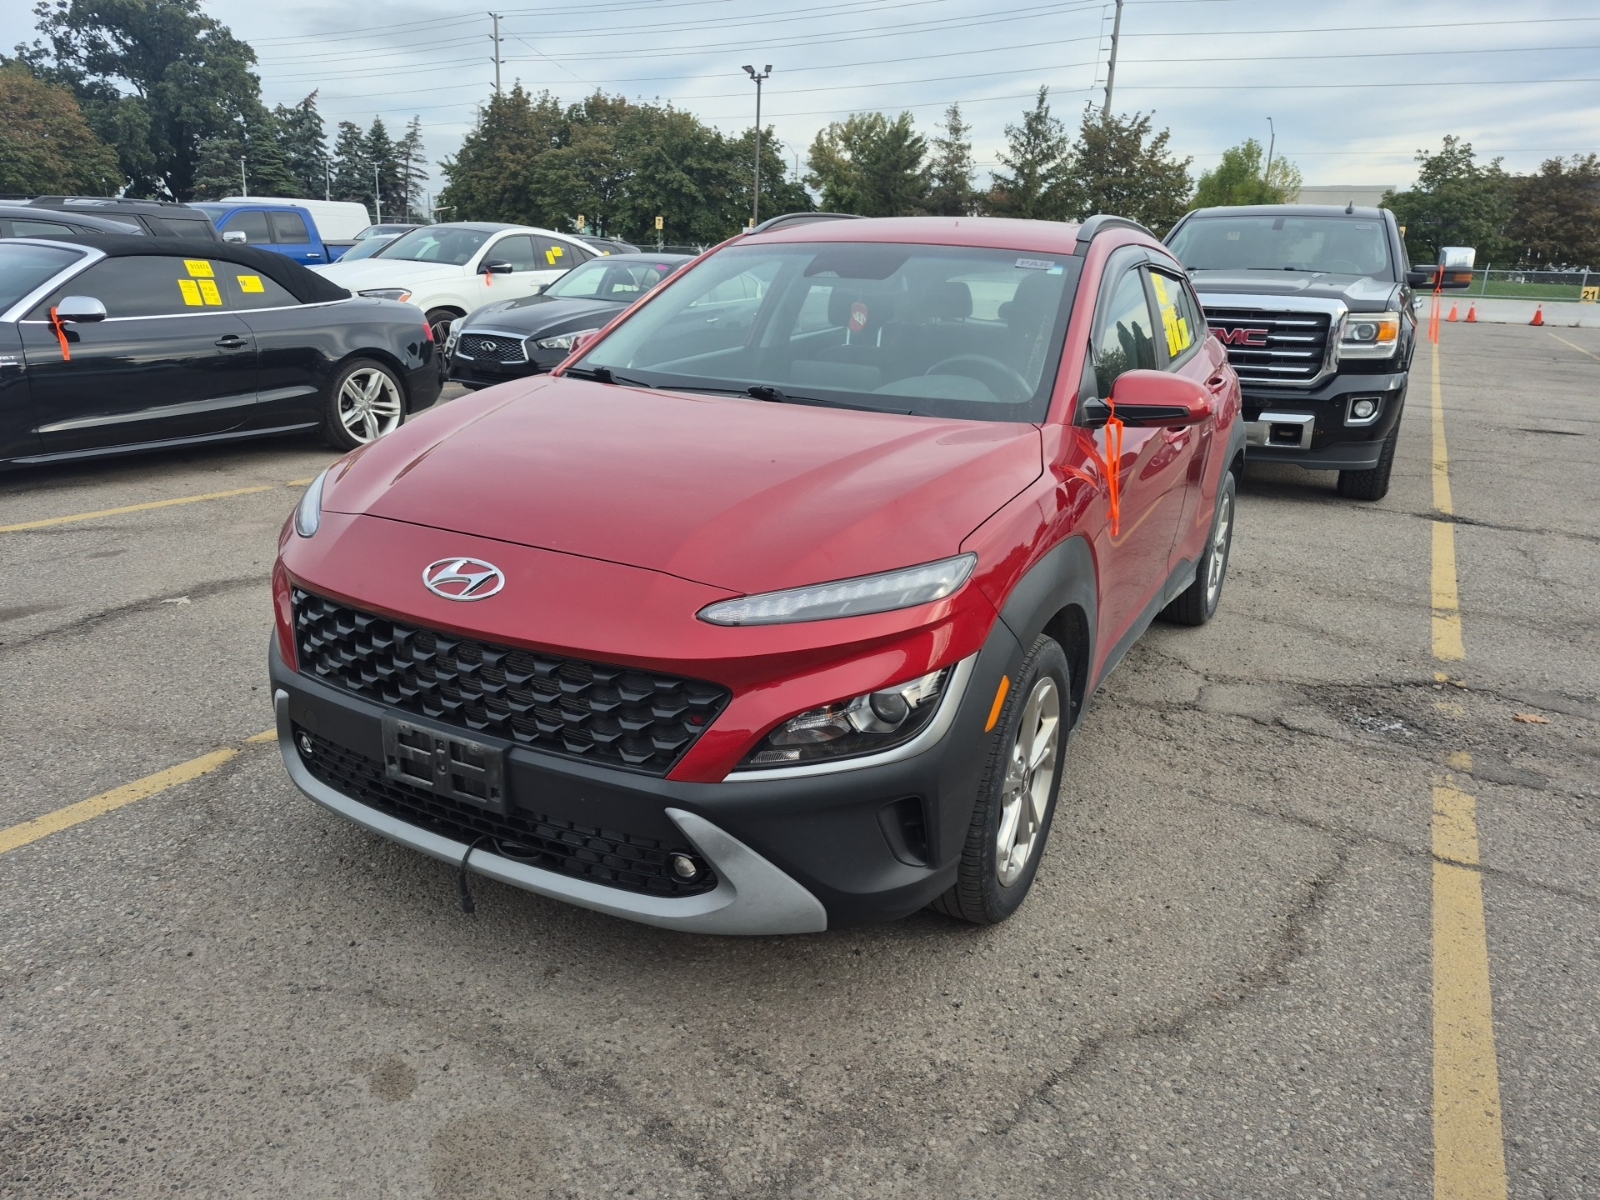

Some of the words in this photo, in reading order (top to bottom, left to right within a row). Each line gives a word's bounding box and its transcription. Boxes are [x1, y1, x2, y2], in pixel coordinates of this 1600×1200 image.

[1020, 260, 1050, 268] PAR
[1582, 290, 1596, 300] 21
[1208, 327, 1268, 346] MC
